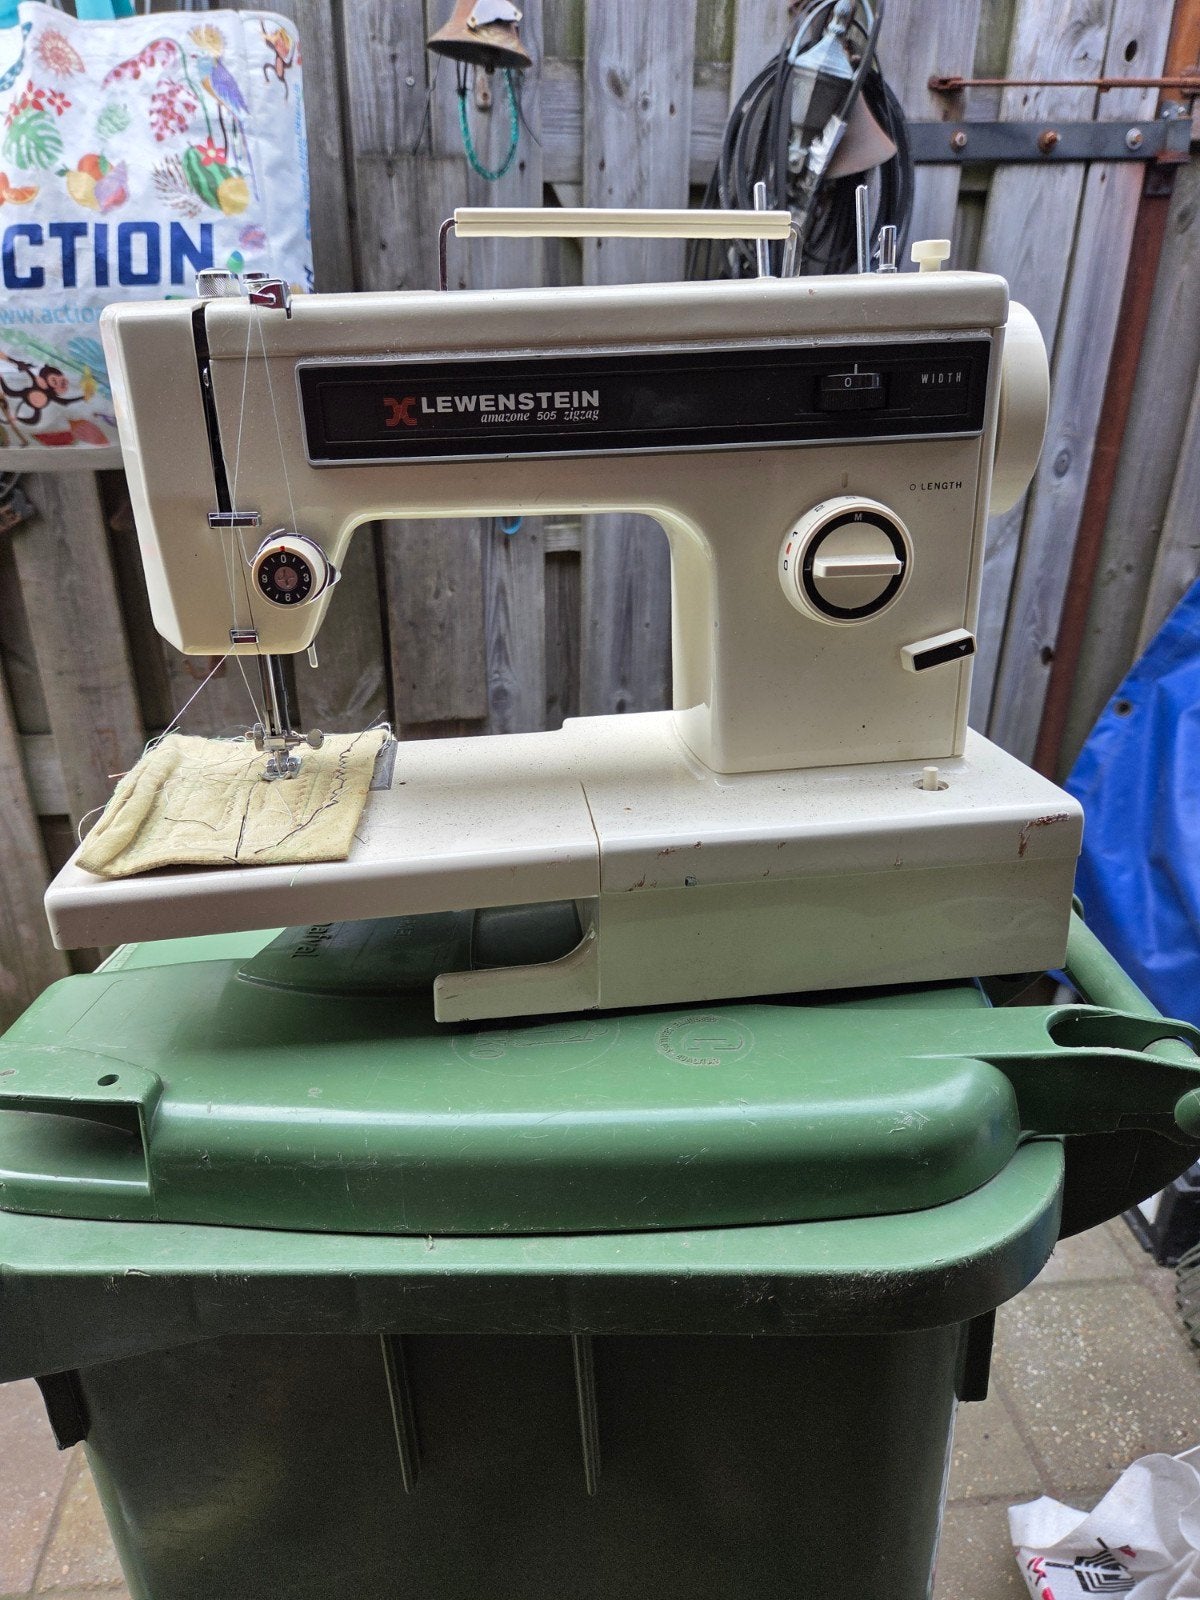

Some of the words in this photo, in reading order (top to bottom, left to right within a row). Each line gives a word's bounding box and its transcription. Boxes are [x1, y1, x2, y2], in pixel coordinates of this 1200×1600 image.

[921, 372, 962, 384] WIDTH
[421, 390, 600, 414] LEWENSTEIN
[480, 412, 530, 423] amazone
[536, 410, 557, 421] 505
[563, 407, 600, 421] zigzag
[921, 481, 963, 491] LENGTH
[280, 554, 287, 564] 0
[261, 574, 268, 584] 9
[302, 573, 310, 583] 3
